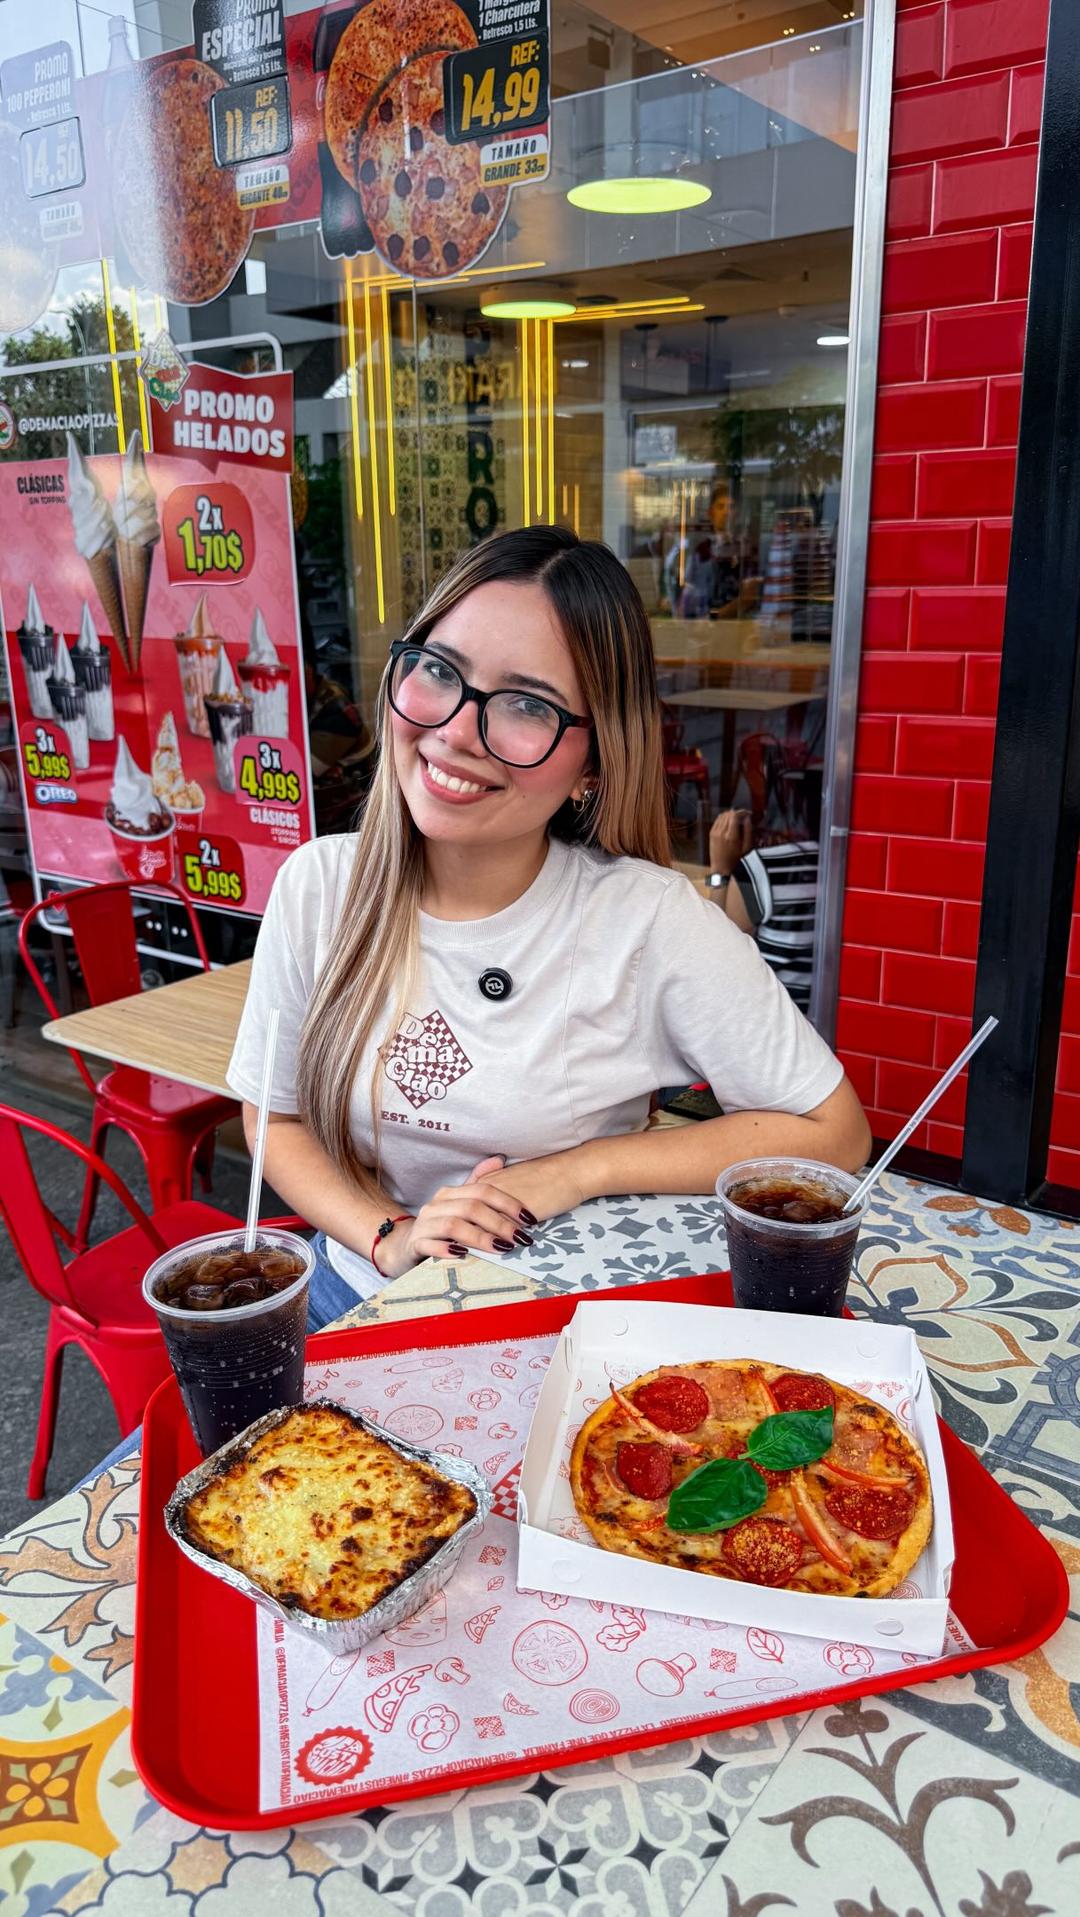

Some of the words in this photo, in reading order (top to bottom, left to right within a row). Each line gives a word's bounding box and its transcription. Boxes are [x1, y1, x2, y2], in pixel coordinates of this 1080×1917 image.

[479, 12, 484, 27] 1
[485, 0, 541, 26] Charcutera
[202, 10, 281, 62] ESPECIAL
[483, 24, 513, 40] Refresco
[511, 40, 541, 67] REF:
[8, 92, 23, 112] 100
[24, 77, 71, 109] PEPPERONI
[255, 85, 278, 108] REF:
[461, 67, 541, 132] 14,99
[492, 139, 537, 161] TAMAÑO
[484, 161, 521, 182] GRANDE
[184, 389, 275, 424] PROMO
[18, 412, 119, 435] @DEMACIAOPIZZAS
[173, 419, 286, 458] HELADOS
[16, 473, 65, 495] CLÁSICAS
[197, 496, 223, 531] 2x
[178, 519, 243, 574] 1,70$
[36, 727, 56, 753] 3x
[25, 744, 71, 779] 5,99$
[259, 742, 281, 769] 3x
[241, 757, 300, 803] 4,99$
[200, 839, 220, 867] 2x
[184, 854, 241, 900] 5,99$
[398, 1012, 438, 1047] De
[406, 1045, 455, 1064] ma
[385, 1056, 447, 1100] Ciao
[381, 1111, 410, 1125] EST.
[418, 1118, 451, 1132] 2011
[412, 1751, 517, 1782] @DEMACIAOPIZZAS
[293, 1772, 410, 1801] #MEGUSTADEMACIAO
